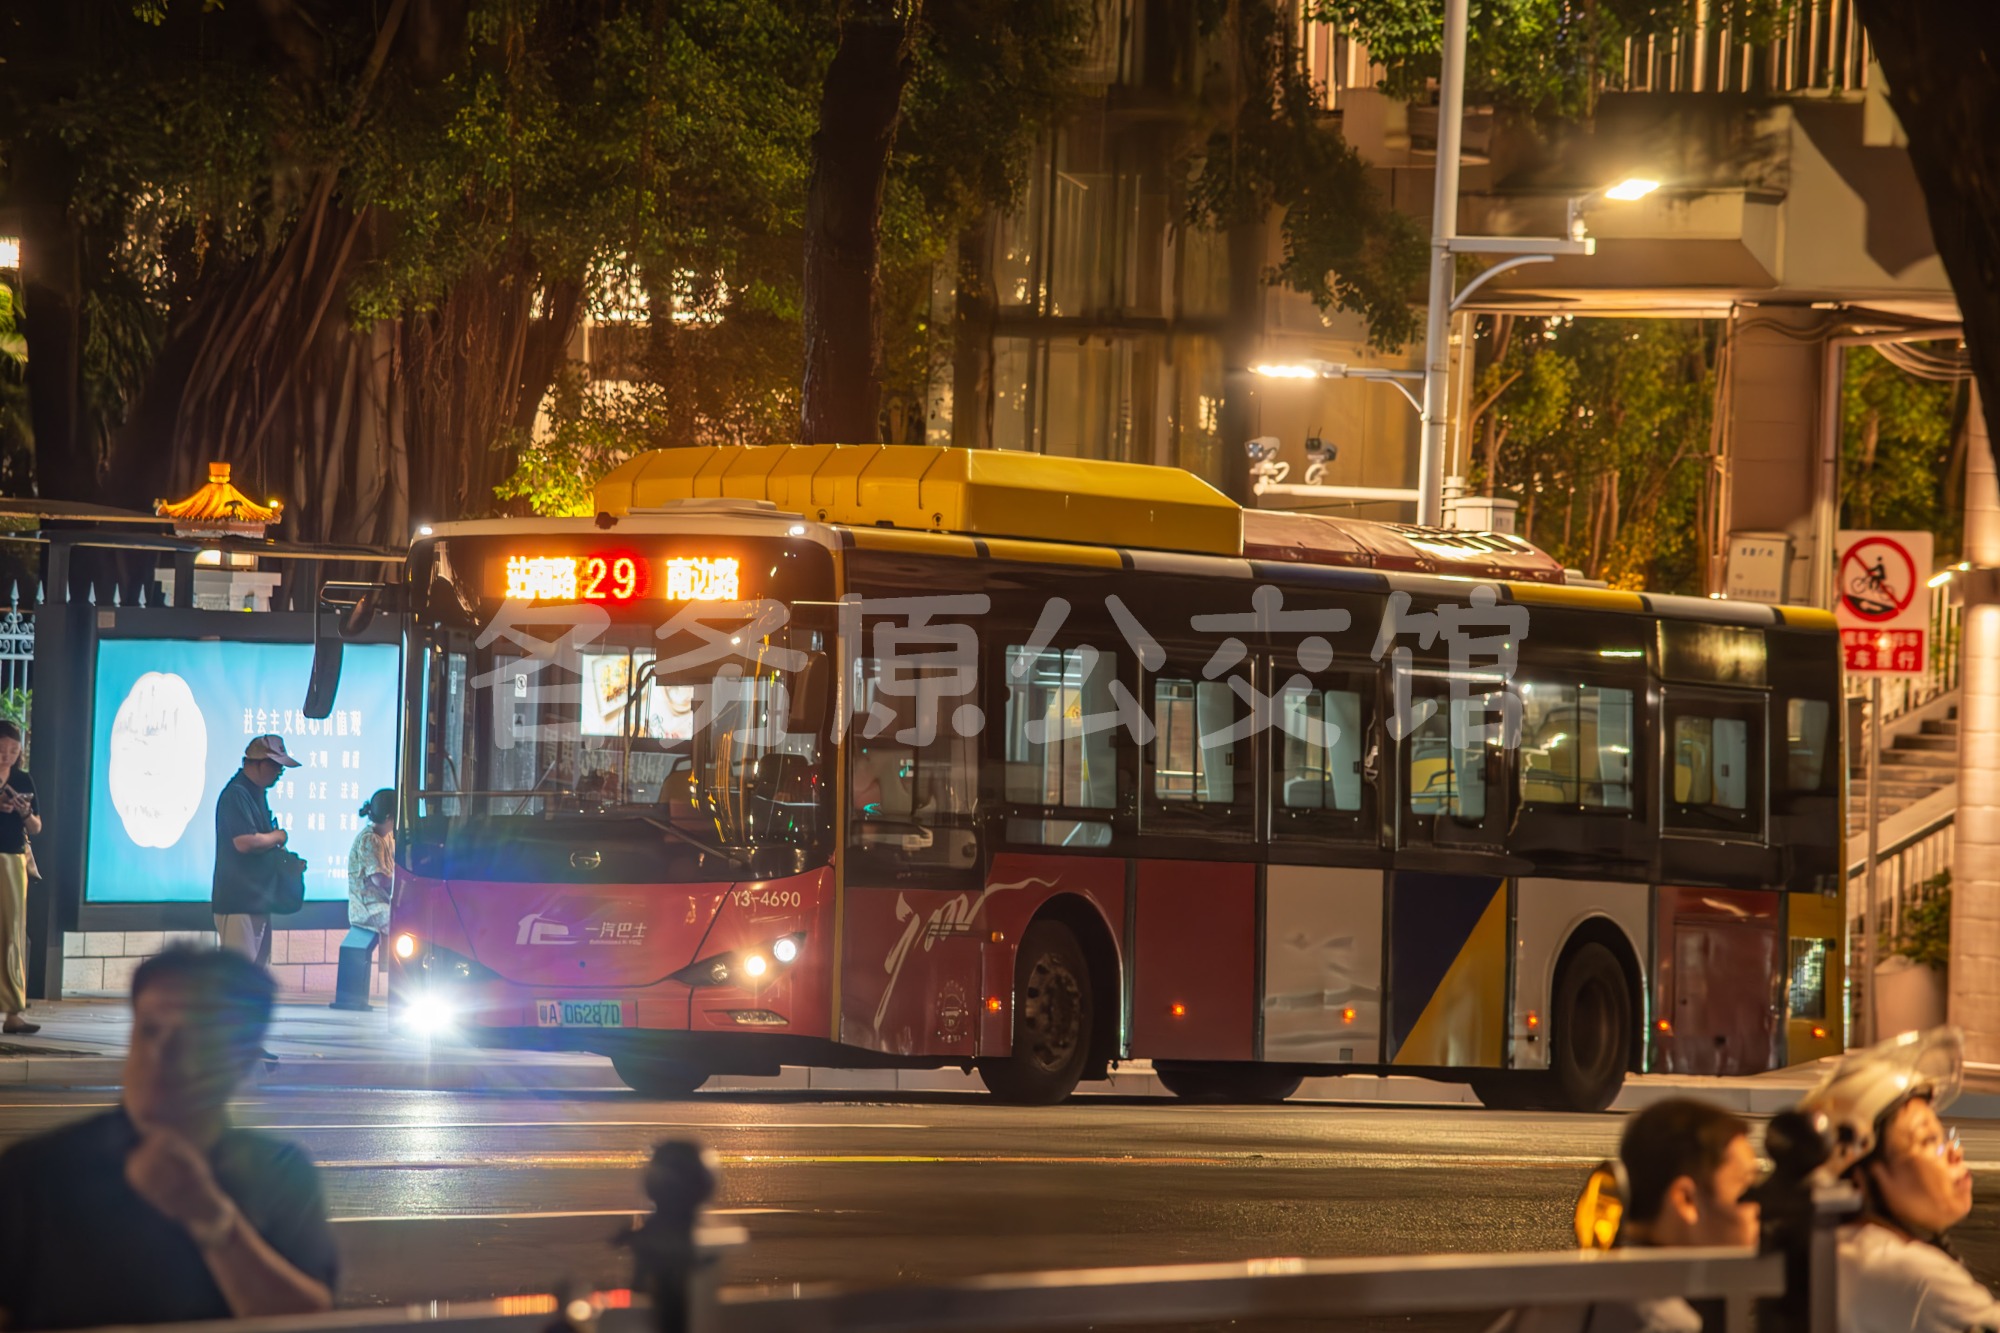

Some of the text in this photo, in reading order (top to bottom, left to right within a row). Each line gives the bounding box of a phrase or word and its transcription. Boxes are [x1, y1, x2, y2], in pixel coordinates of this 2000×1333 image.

[585, 558, 636, 599] 29
[667, 557, 739, 600] 南边路
[243, 708, 362, 736] 社会主义核心价值观
[731, 890, 801, 908] Y3-4690
[585, 921, 648, 938] 一汽巴士
